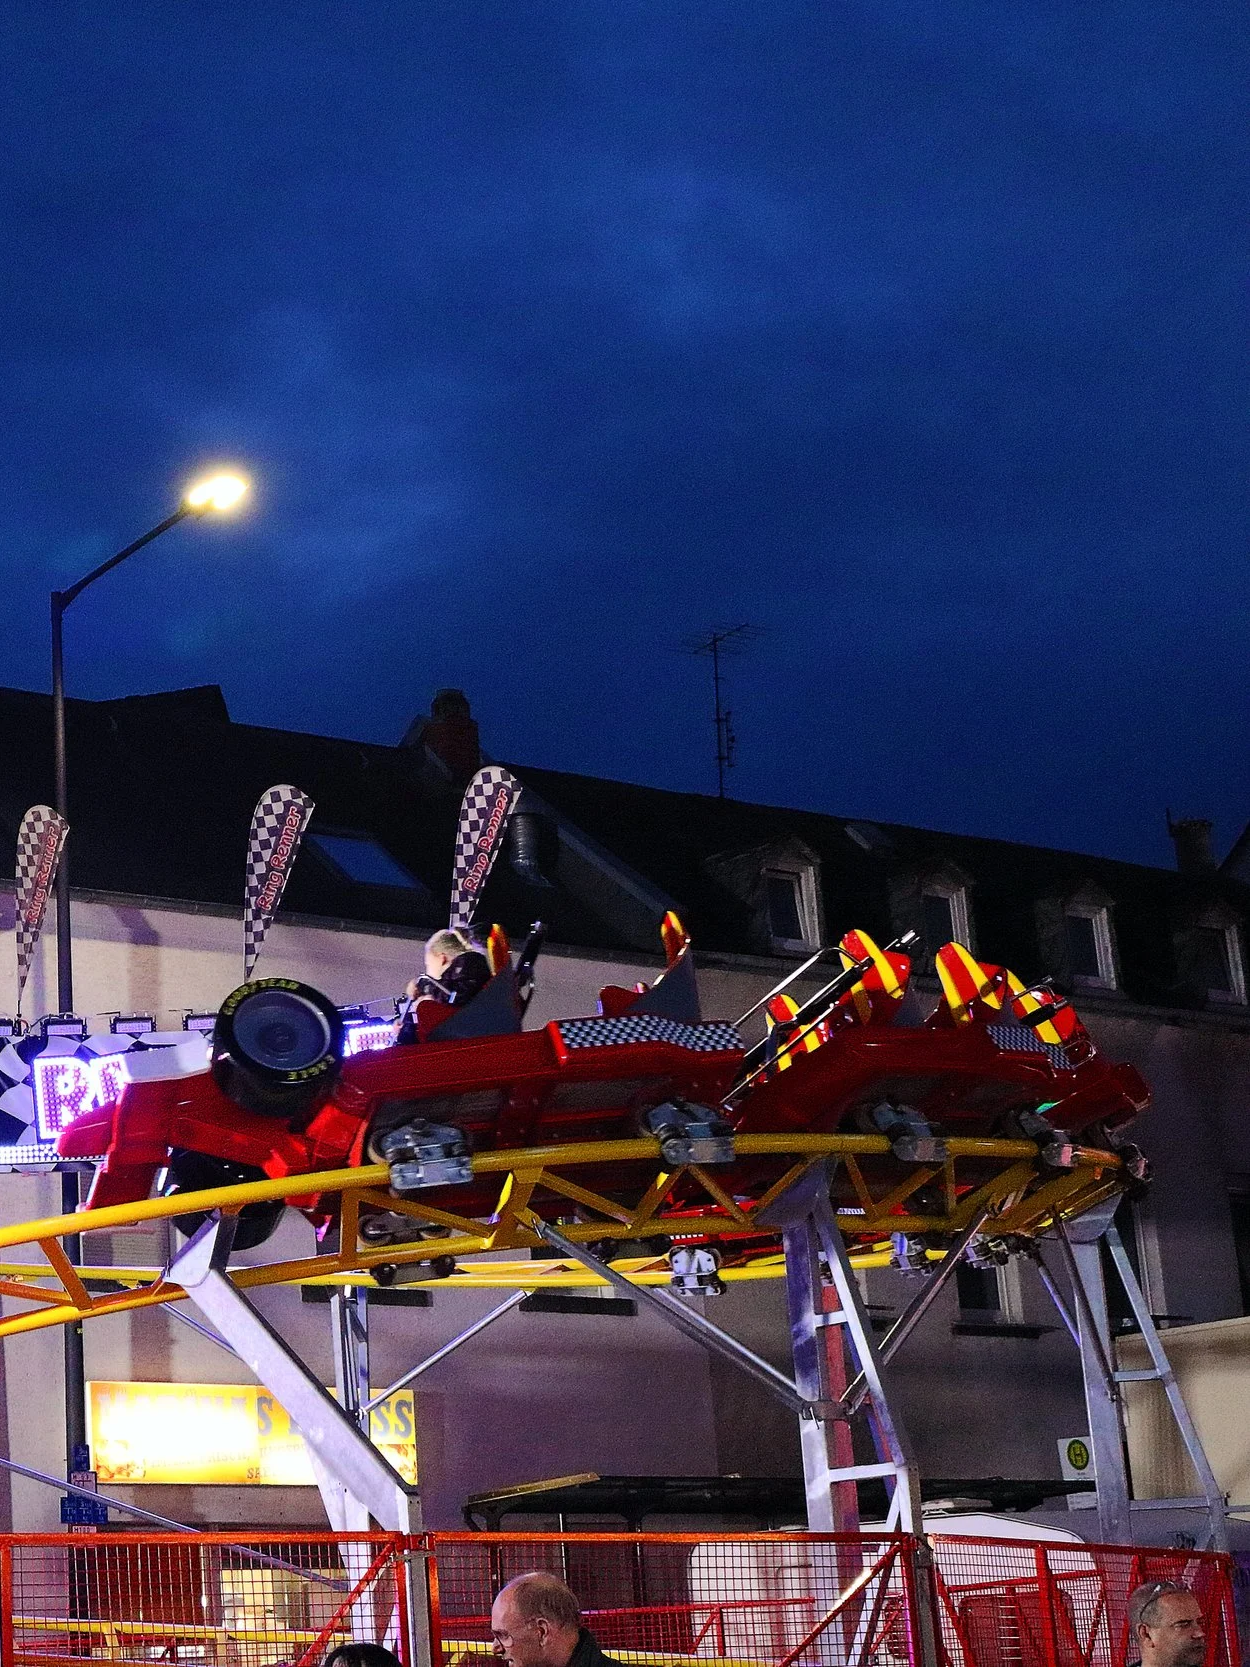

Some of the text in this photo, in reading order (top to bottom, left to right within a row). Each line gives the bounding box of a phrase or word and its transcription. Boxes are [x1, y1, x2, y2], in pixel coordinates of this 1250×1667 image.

[26, 826, 58, 924] Ring Renner
[256, 806, 300, 910] Ring Renner
[463, 788, 507, 892] Ring Renner
